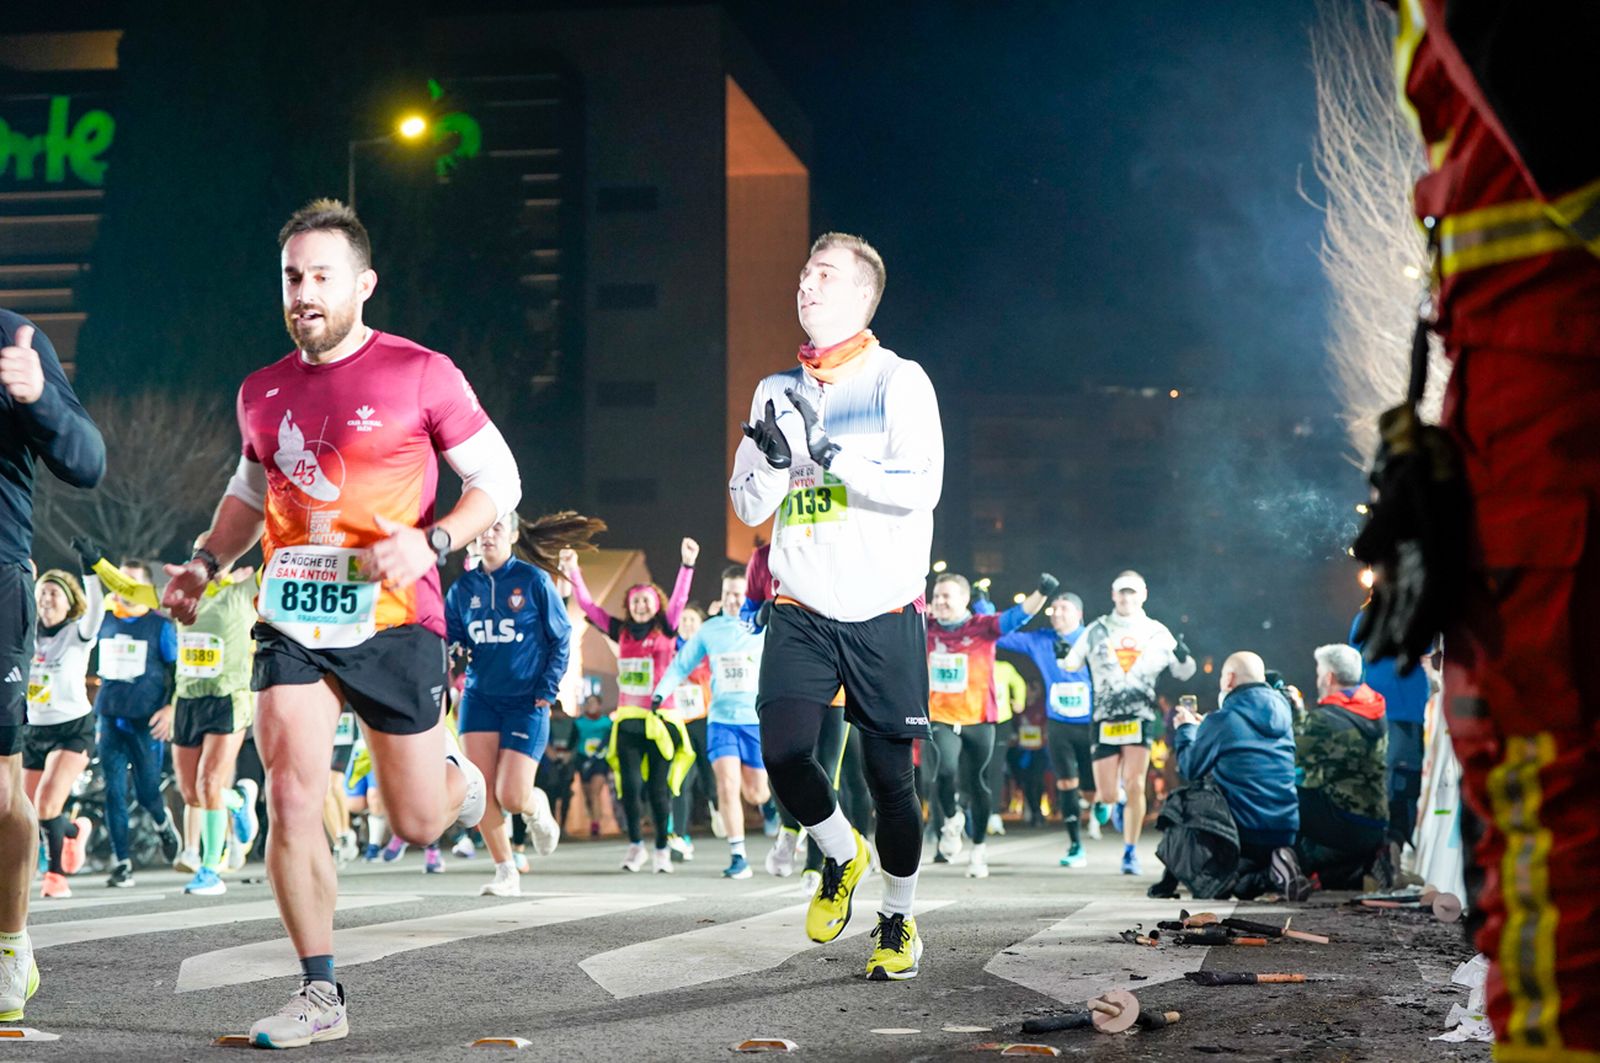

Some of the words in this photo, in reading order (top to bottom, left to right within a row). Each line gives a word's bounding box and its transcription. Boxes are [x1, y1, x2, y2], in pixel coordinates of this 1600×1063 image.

[0, 95, 116, 187] rte
[293, 459, 317, 486] 43
[309, 530, 346, 546] ANTÓN
[310, 523, 331, 533] SAN
[290, 556, 321, 568] NOCHE
[324, 558, 338, 568] DE
[276, 568, 296, 578] SAN
[299, 568, 338, 581] ANTÓN
[281, 581, 358, 614] 8365
[468, 618, 524, 644] GLS.
